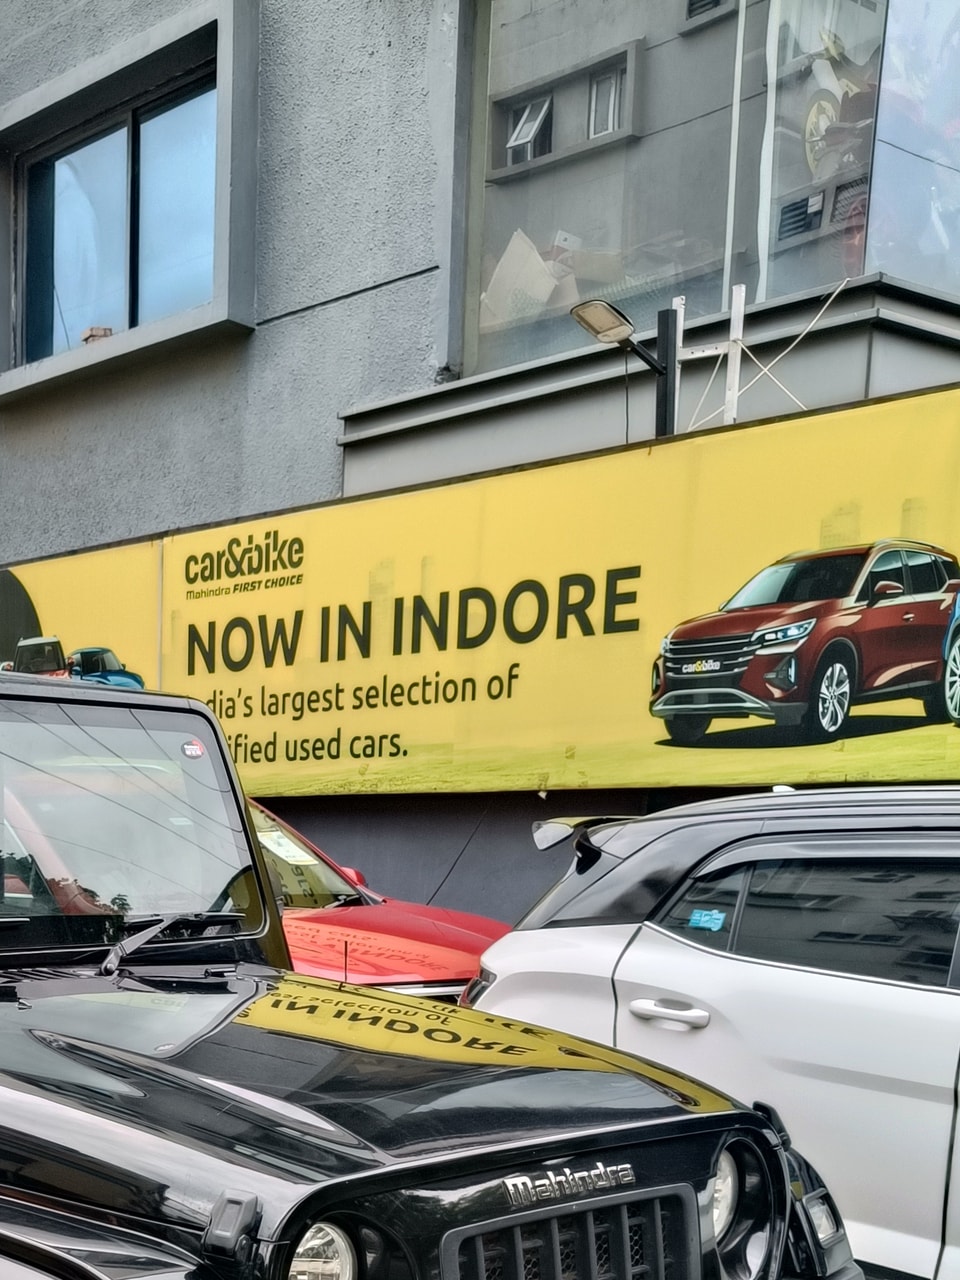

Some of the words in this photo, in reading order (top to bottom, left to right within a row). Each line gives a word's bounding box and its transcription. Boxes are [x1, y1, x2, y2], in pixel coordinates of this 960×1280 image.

[185, 530, 304, 584] car&bike
[186, 586, 231, 601] Mahindra
[232, 580, 263, 594] FIRST
[264, 574, 303, 589] CHOICE
[187, 609, 304, 676] NOW
[320, 601, 372, 663] IN
[393, 565, 641, 656] INDORE
[682, 660, 721, 674] car&bike
[206, 687, 253, 719] dia's
[260, 682, 345, 721] largest
[352, 671, 477, 710] selection
[487, 662, 520, 700] of
[228, 731, 277, 764] ified
[285, 727, 342, 762] used
[349, 733, 408, 759] cars.
[504, 1162, 637, 1206] Mahindra
